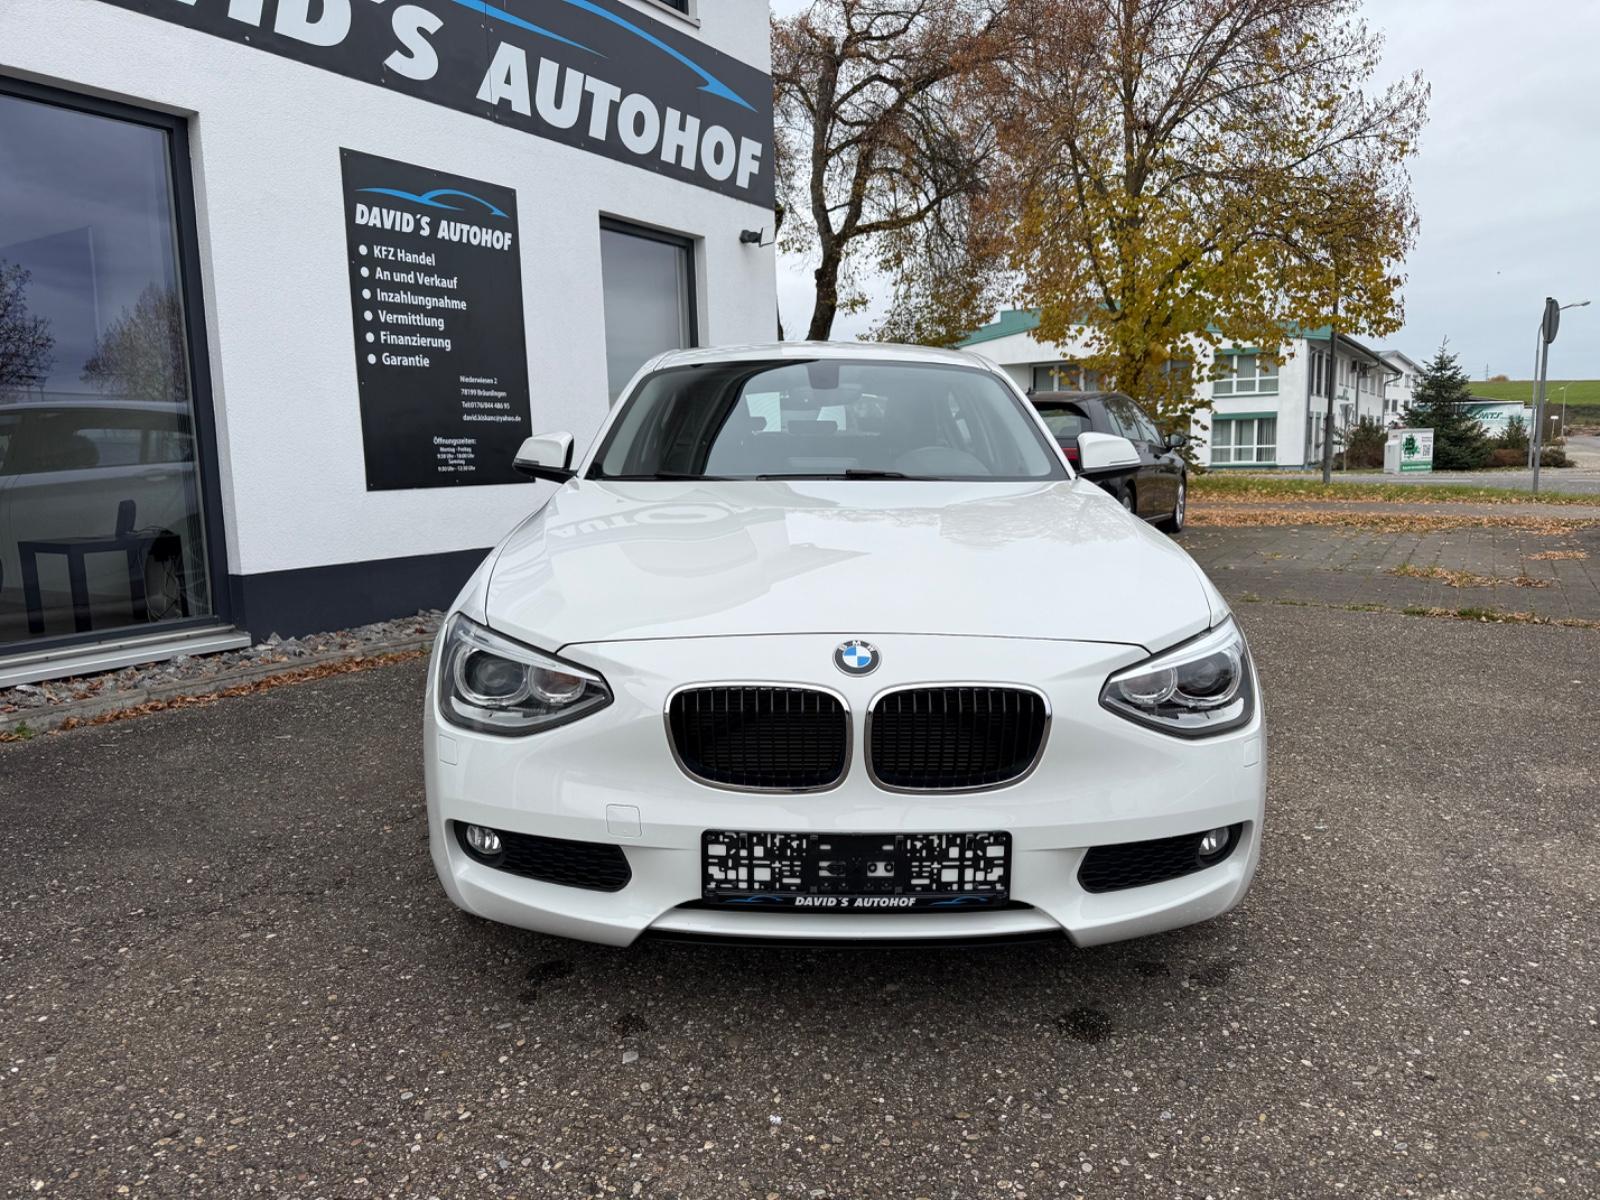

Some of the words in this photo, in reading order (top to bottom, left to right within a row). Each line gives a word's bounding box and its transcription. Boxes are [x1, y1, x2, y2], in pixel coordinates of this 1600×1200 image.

[476, 41, 762, 189] AUTOHOF
[437, 219, 513, 251] AUTOHOF
[373, 245, 395, 260] KFZ
[397, 248, 436, 266] Handel
[375, 267, 391, 281] An
[393, 270, 415, 284] und
[417, 272, 458, 289] Verkauf
[377, 288, 467, 310] Inzahlungnahme
[378, 310, 445, 331] Vermittlung
[380, 331, 452, 351] Finanzierung
[381, 352, 430, 367] Garantie
[838, 640, 879, 651] BMW
[854, 897, 916, 907] AUTOHOF
